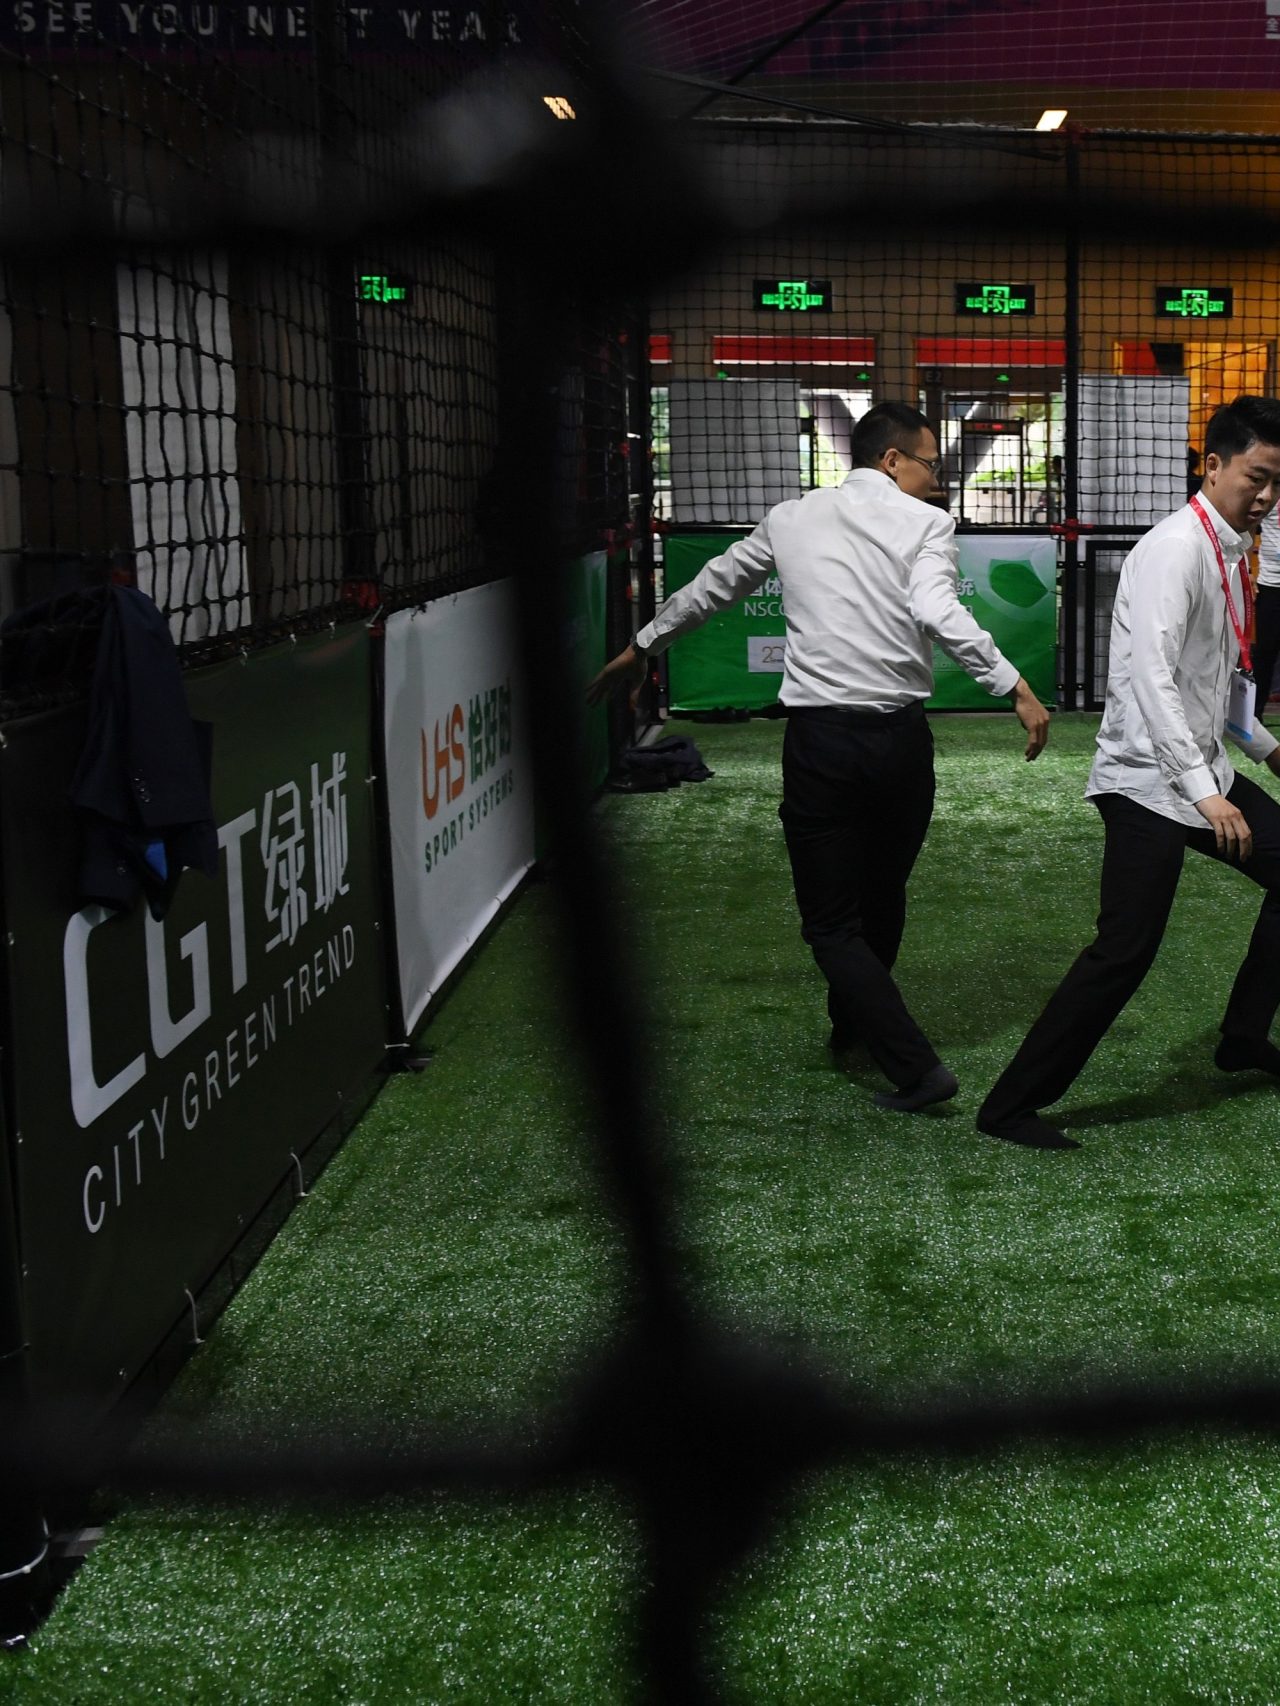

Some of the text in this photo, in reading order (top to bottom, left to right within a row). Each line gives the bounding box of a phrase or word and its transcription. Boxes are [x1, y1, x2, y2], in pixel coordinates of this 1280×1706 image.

[15, 1, 96, 34] SEE
[120, 3, 219, 36] YOU
[247, 6, 374, 40] NET
[421, 703, 465, 820] UHS
[424, 769, 514, 873] SPORT SYSTEMS
[260, 751, 350, 954] 绿城
[63, 807, 257, 1129] CGT
[83, 923, 356, 1234] CITY GREEN TREND
